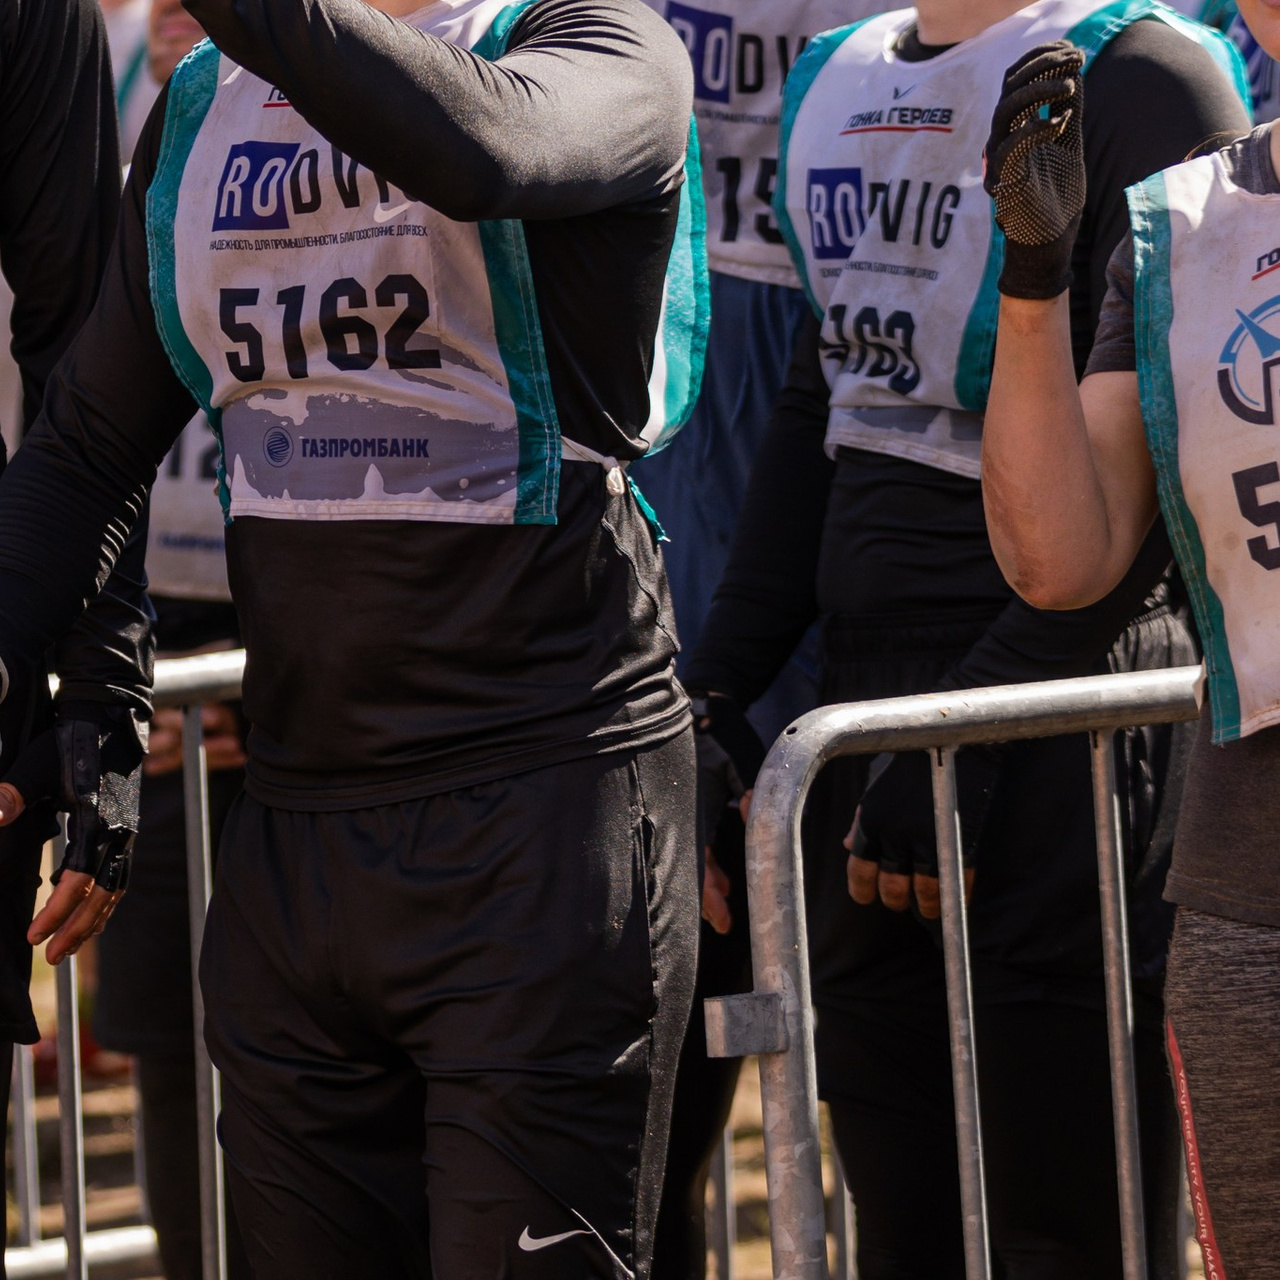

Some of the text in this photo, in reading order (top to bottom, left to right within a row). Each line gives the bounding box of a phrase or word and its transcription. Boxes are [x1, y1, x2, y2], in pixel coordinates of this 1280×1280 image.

[886, 107, 954, 125] ГЕРОЕВ
[219, 143, 418, 217] RODV
[219, 273, 442, 383] 5162
[302, 438, 429, 458] ГАЗПРОМБАНК
[1232, 461, 1280, 571] 5
[1179, 1069, 1189, 1115] YOUR
[1185, 1120, 1199, 1186] REALITY
[1195, 1192, 1208, 1239] YOUR
